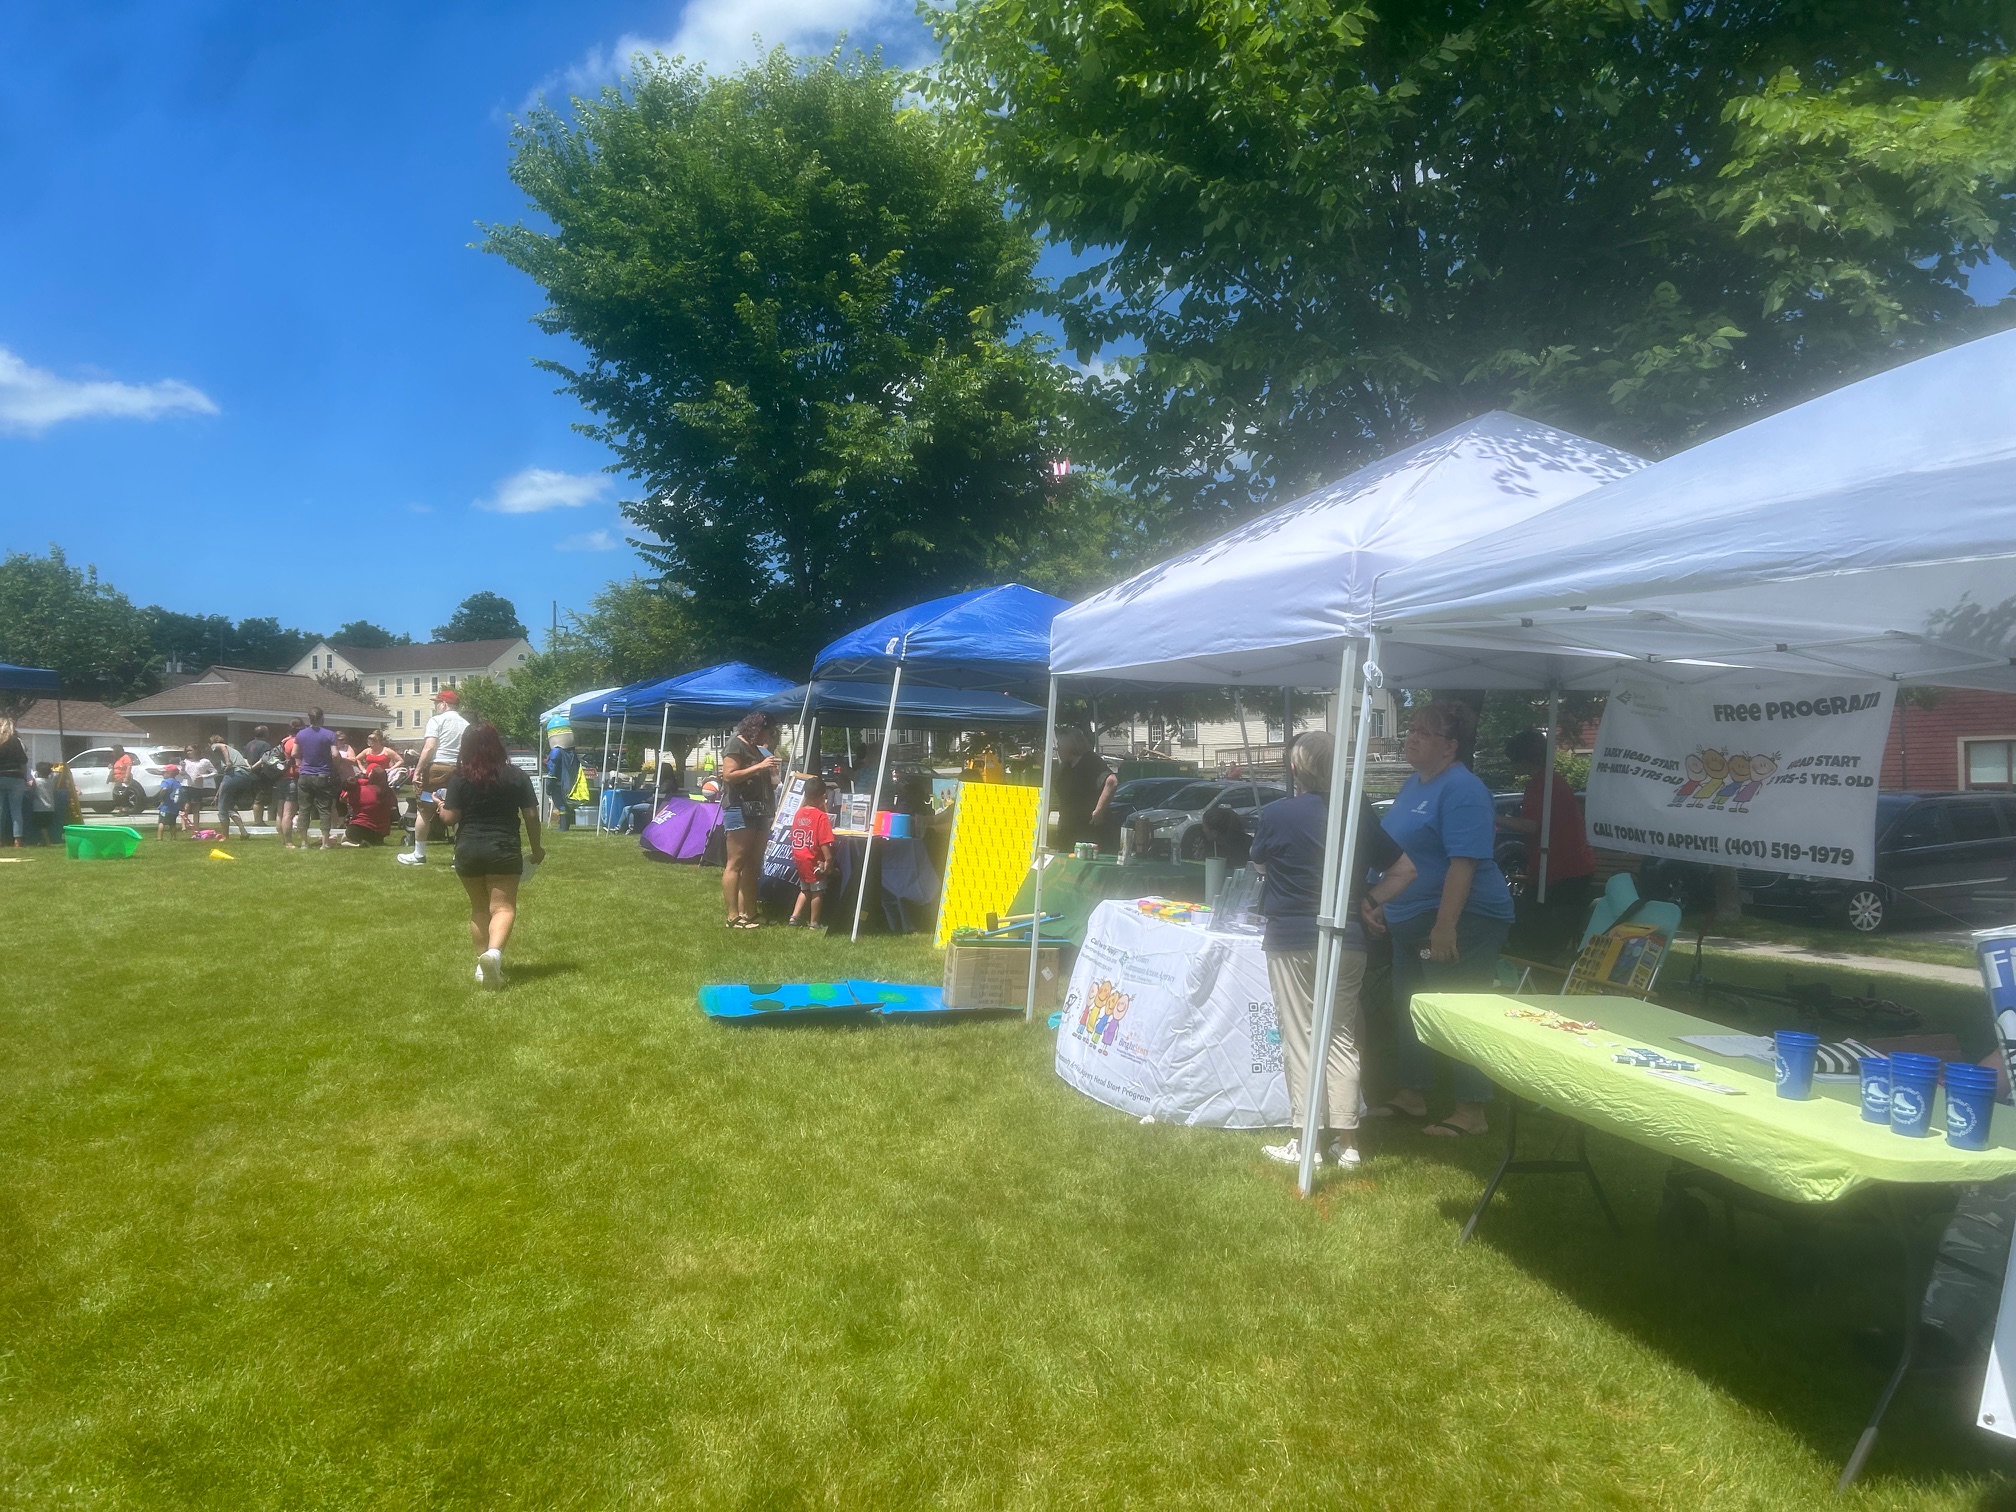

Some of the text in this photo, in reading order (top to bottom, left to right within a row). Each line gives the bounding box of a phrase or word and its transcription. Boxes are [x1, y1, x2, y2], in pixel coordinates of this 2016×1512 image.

[1650, 757, 1680, 771] START
[1814, 755, 1861, 768] START
[1640, 768, 1663, 781] YRS
[1662, 775, 1685, 785] OLD
[1811, 773, 1842, 786] YRS.
[1844, 775, 1874, 788] OLD
[792, 829, 814, 849] 34
[1593, 822, 1855, 866] CALL TODAY TO APPLY!! (401) 519-1979
[1094, 1075, 1108, 1087] Head
[1107, 1081, 1121, 1092] Start
[1121, 1086, 1151, 1103] Program
